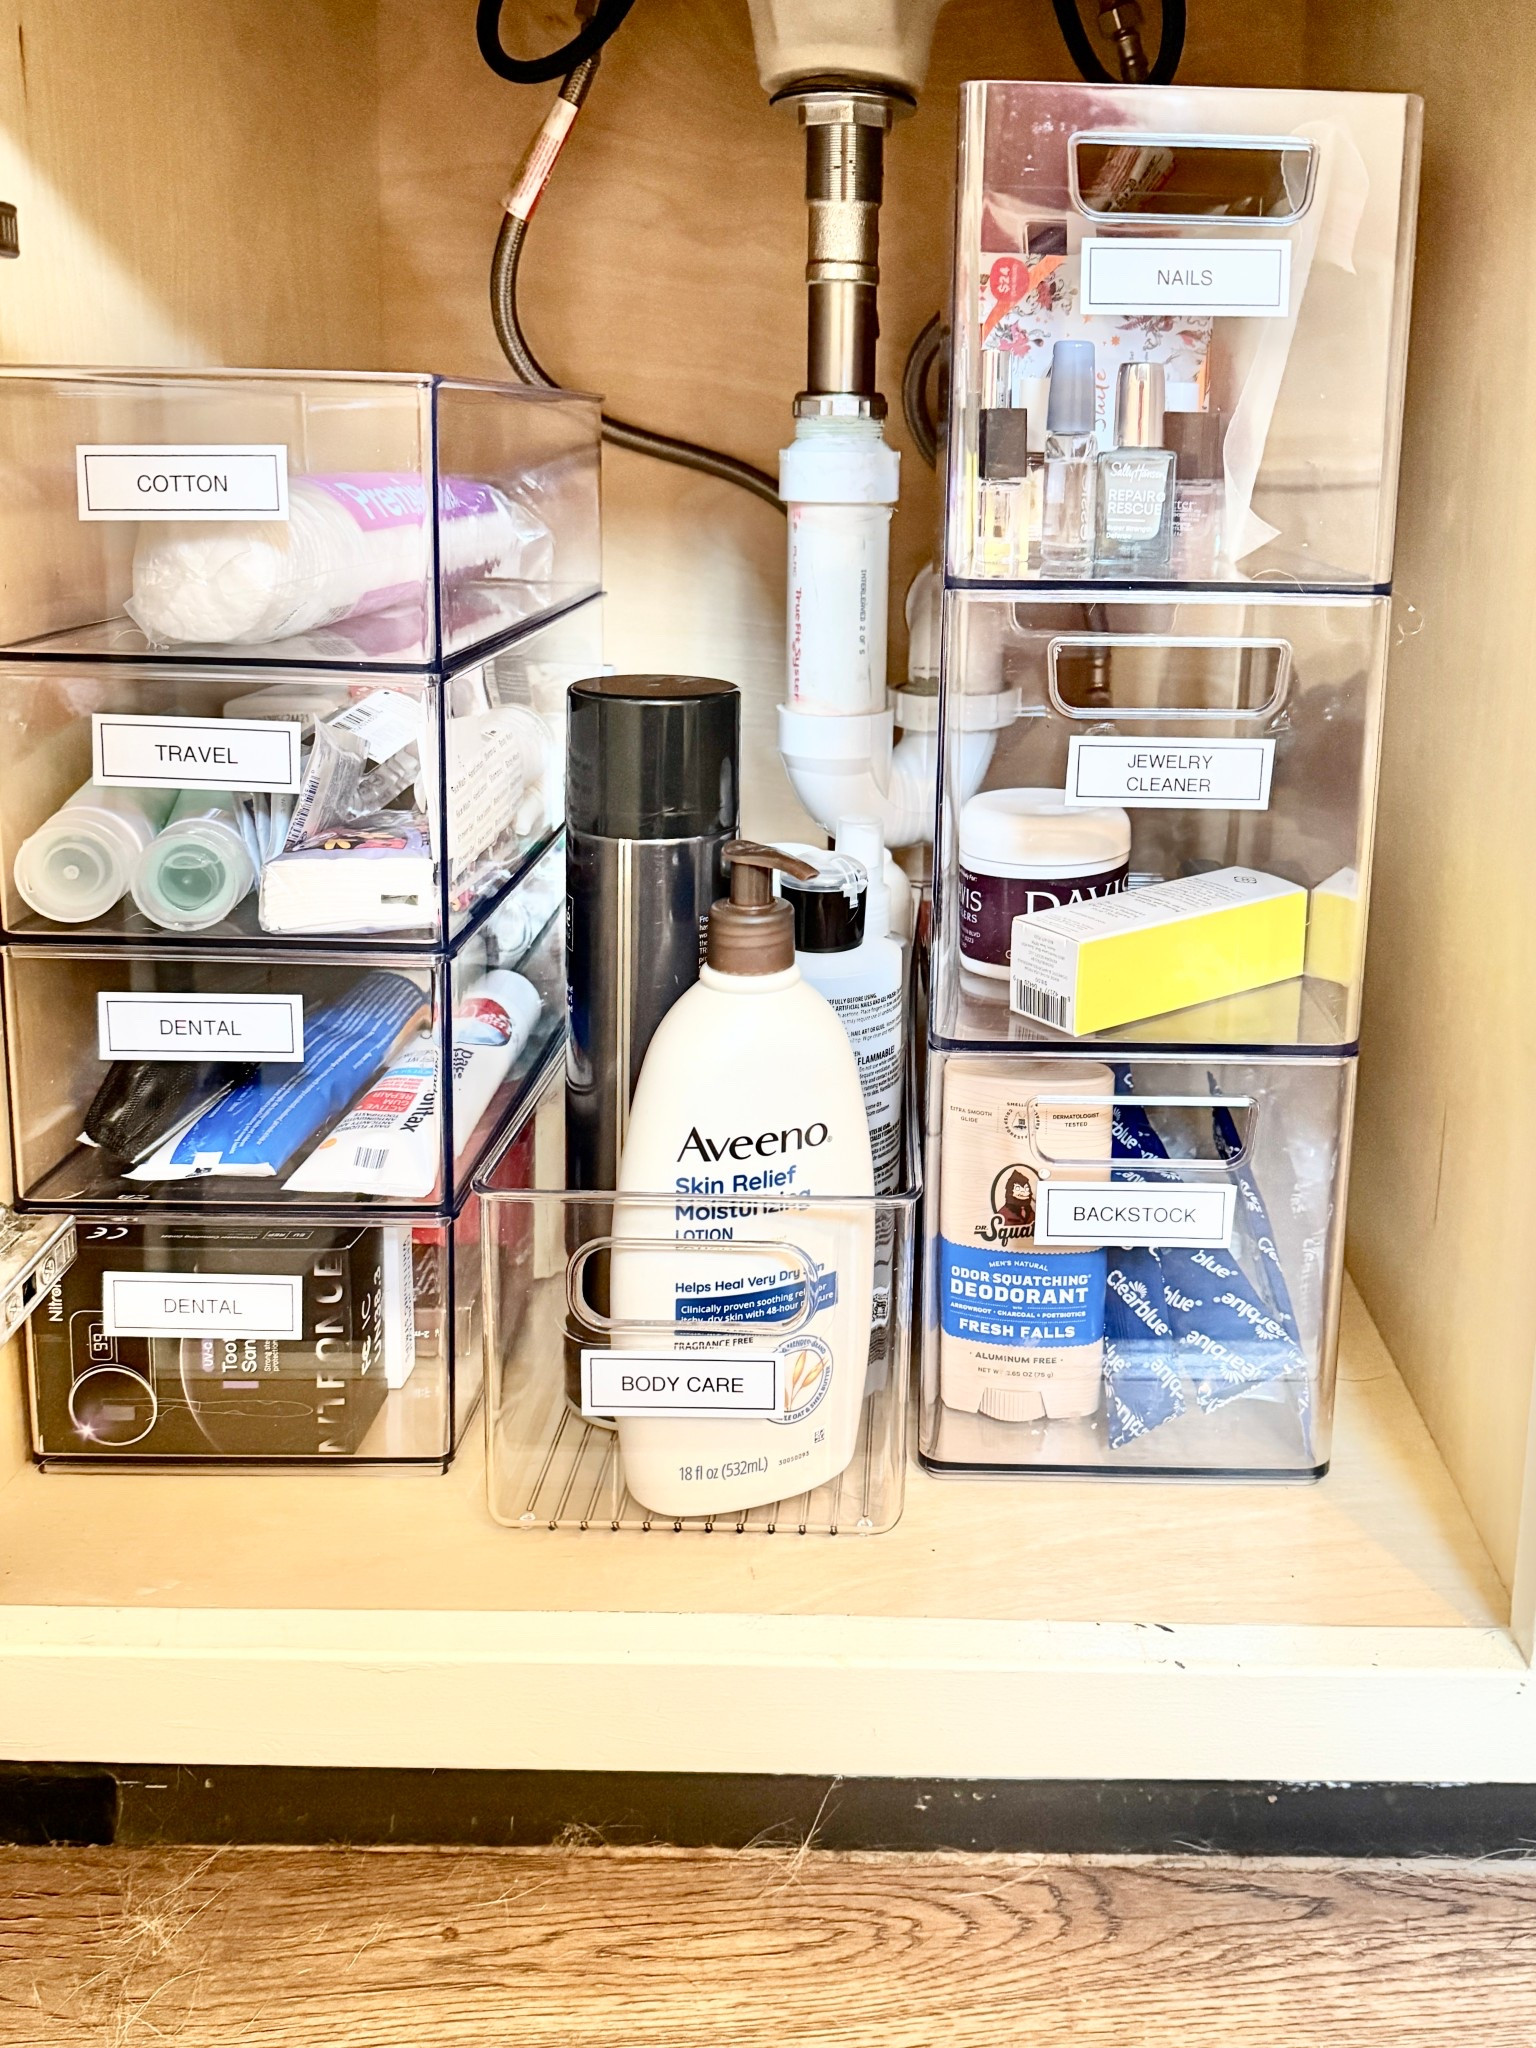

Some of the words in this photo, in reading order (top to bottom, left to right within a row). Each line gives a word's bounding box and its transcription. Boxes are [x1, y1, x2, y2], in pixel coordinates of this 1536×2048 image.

[1157, 269, 1214, 286] NAILS
[136, 474, 228, 493] COTTON
[1107, 488, 1156, 502] REPAIR
[1106, 501, 1162, 515] RESCUE
[154, 744, 239, 765] TRAVEL
[1127, 753, 1213, 771] JEWELRY
[1126, 776, 1212, 793] CLEANER
[835, 1003, 860, 1012] ARTIFICIAL
[159, 1019, 242, 1036] DENTAL
[857, 1045, 895, 1066] FLAMMABLE!
[967, 1107, 993, 1117] SMOOTH
[1052, 1112, 1100, 1120] DERMATOLOGIST
[676, 1122, 829, 1163] Aveeno
[675, 1176, 724, 1195] Skin
[732, 1164, 797, 1193] Relief
[1073, 1205, 1197, 1224] BACKSTOCK
[951, 1265, 990, 1282] ODOR
[1014, 1260, 1049, 1272] NATURAL
[675, 1281, 712, 1295] Helps
[715, 1278, 744, 1292] Heal
[747, 1273, 777, 1287] Very
[779, 1267, 801, 1282] Dry
[950, 1278, 1089, 1304] DEODORANT
[164, 1298, 243, 1315] DENTAL
[680, 1303, 721, 1315] Clinically
[723, 1300, 755, 1314] proven
[757, 1292, 794, 1308] soothing
[950, 1302, 992, 1315] ARROWROOT
[997, 1310, 1036, 1319] CHARCOAL
[1106, 1269, 1170, 1336] Clearblue
[724, 1312, 744, 1322] skin
[745, 1308, 765, 1320] with
[766, 1302, 800, 1316] 48-hour
[959, 1317, 1014, 1337] FRESH
[1020, 1325, 1076, 1339] FALLS
[732, 1336, 754, 1345] FREE
[202, 1340, 214, 1367] UV-C
[975, 1351, 1031, 1365] ALUMINUM
[1033, 1357, 1058, 1365] FREE
[621, 1375, 681, 1392] BODY
[686, 1376, 745, 1393] CARE
[792, 1409, 806, 1421] OAT
[809, 1391, 825, 1410] SHEA
[821, 1365, 832, 1393] BUTTER
[679, 1466, 693, 1481] 18
[695, 1465, 704, 1480] fl
[706, 1468, 719, 1480] oz
[721, 1456, 769, 1481] (532mL)
